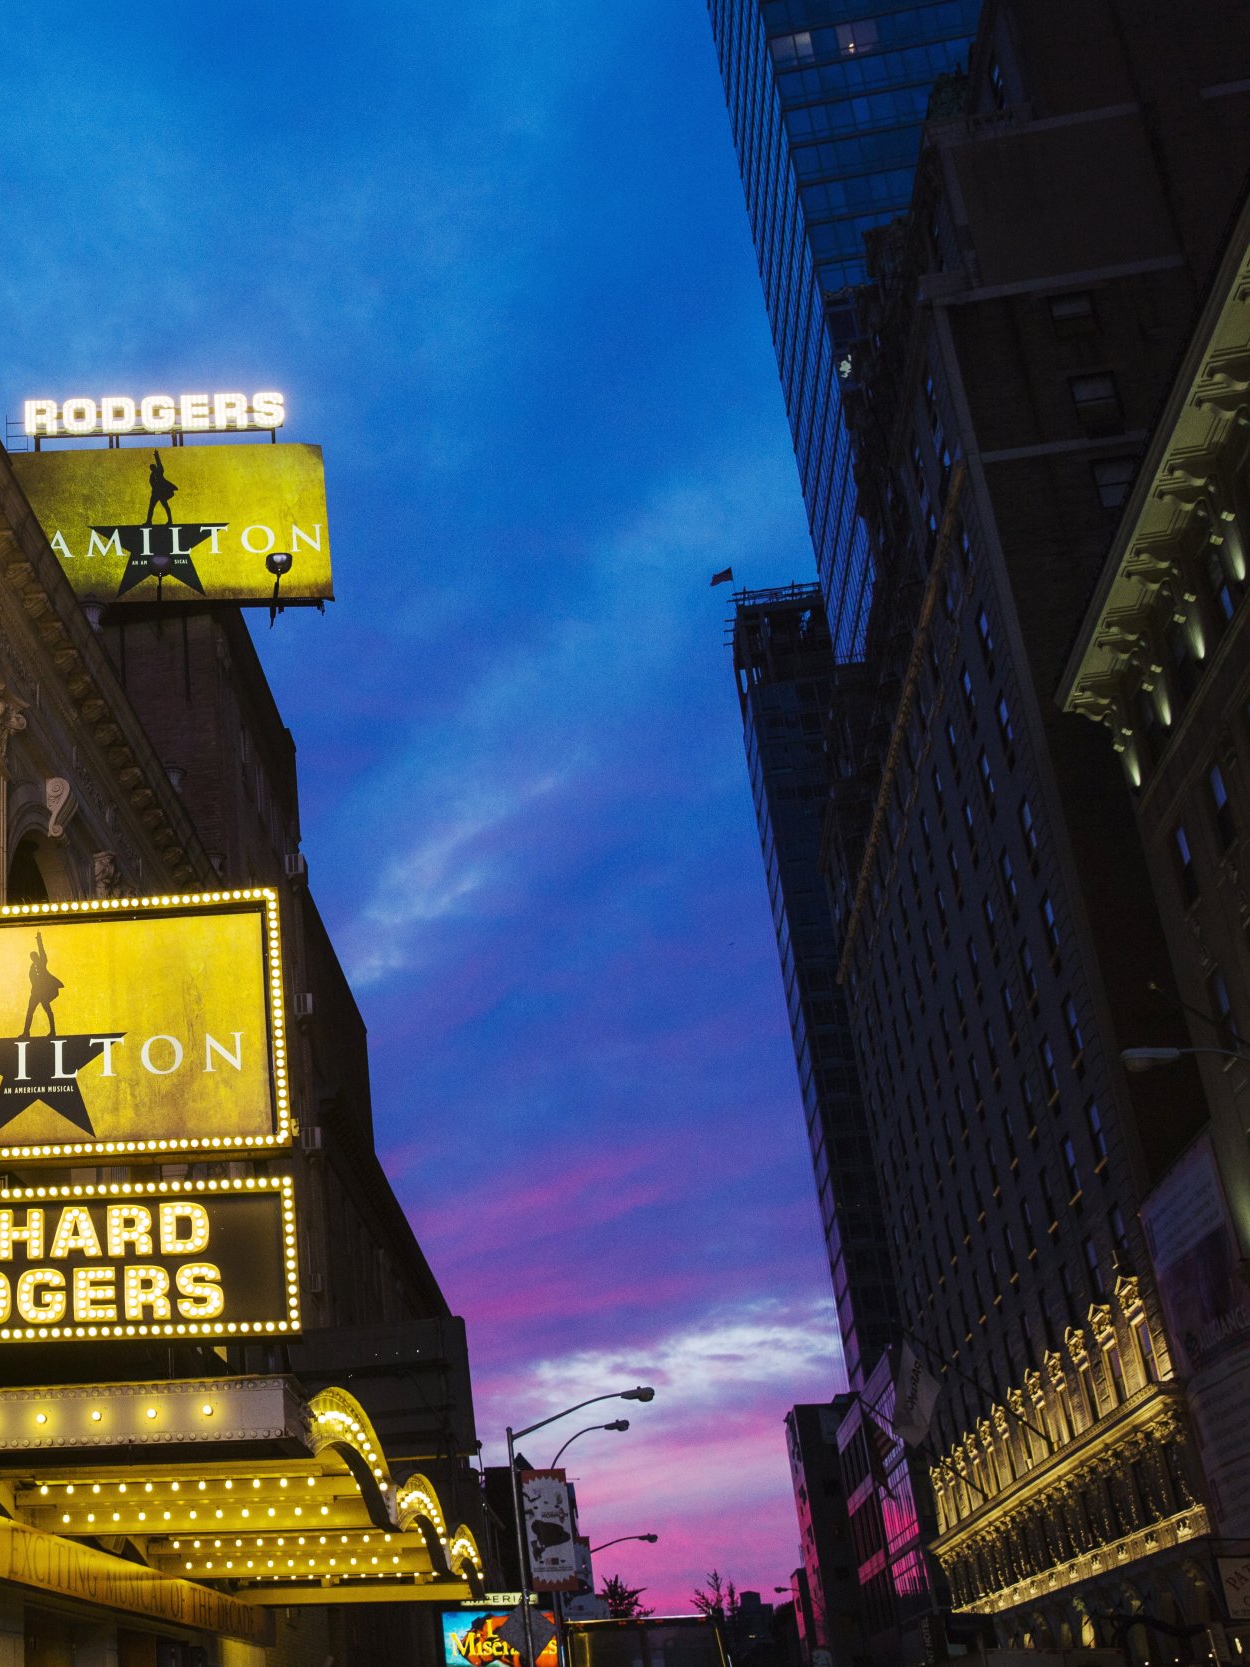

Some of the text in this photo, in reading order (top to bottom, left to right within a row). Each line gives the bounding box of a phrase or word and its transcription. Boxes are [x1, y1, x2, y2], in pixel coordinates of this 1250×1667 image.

[23, 391, 285, 436] RODGERS
[50, 523, 323, 558] AMILTON
[3, 1085, 74, 1095] AN AMERICAN MUSICAL
[8, 1526, 98, 1598] EXCITING
[105, 1569, 166, 1615] MUSICAL
[170, 1581, 186, 1619] OF
[190, 1587, 213, 1628] THE
[217, 1596, 254, 1641] DECADE
[450, 1632, 558, 1656] Misérs
